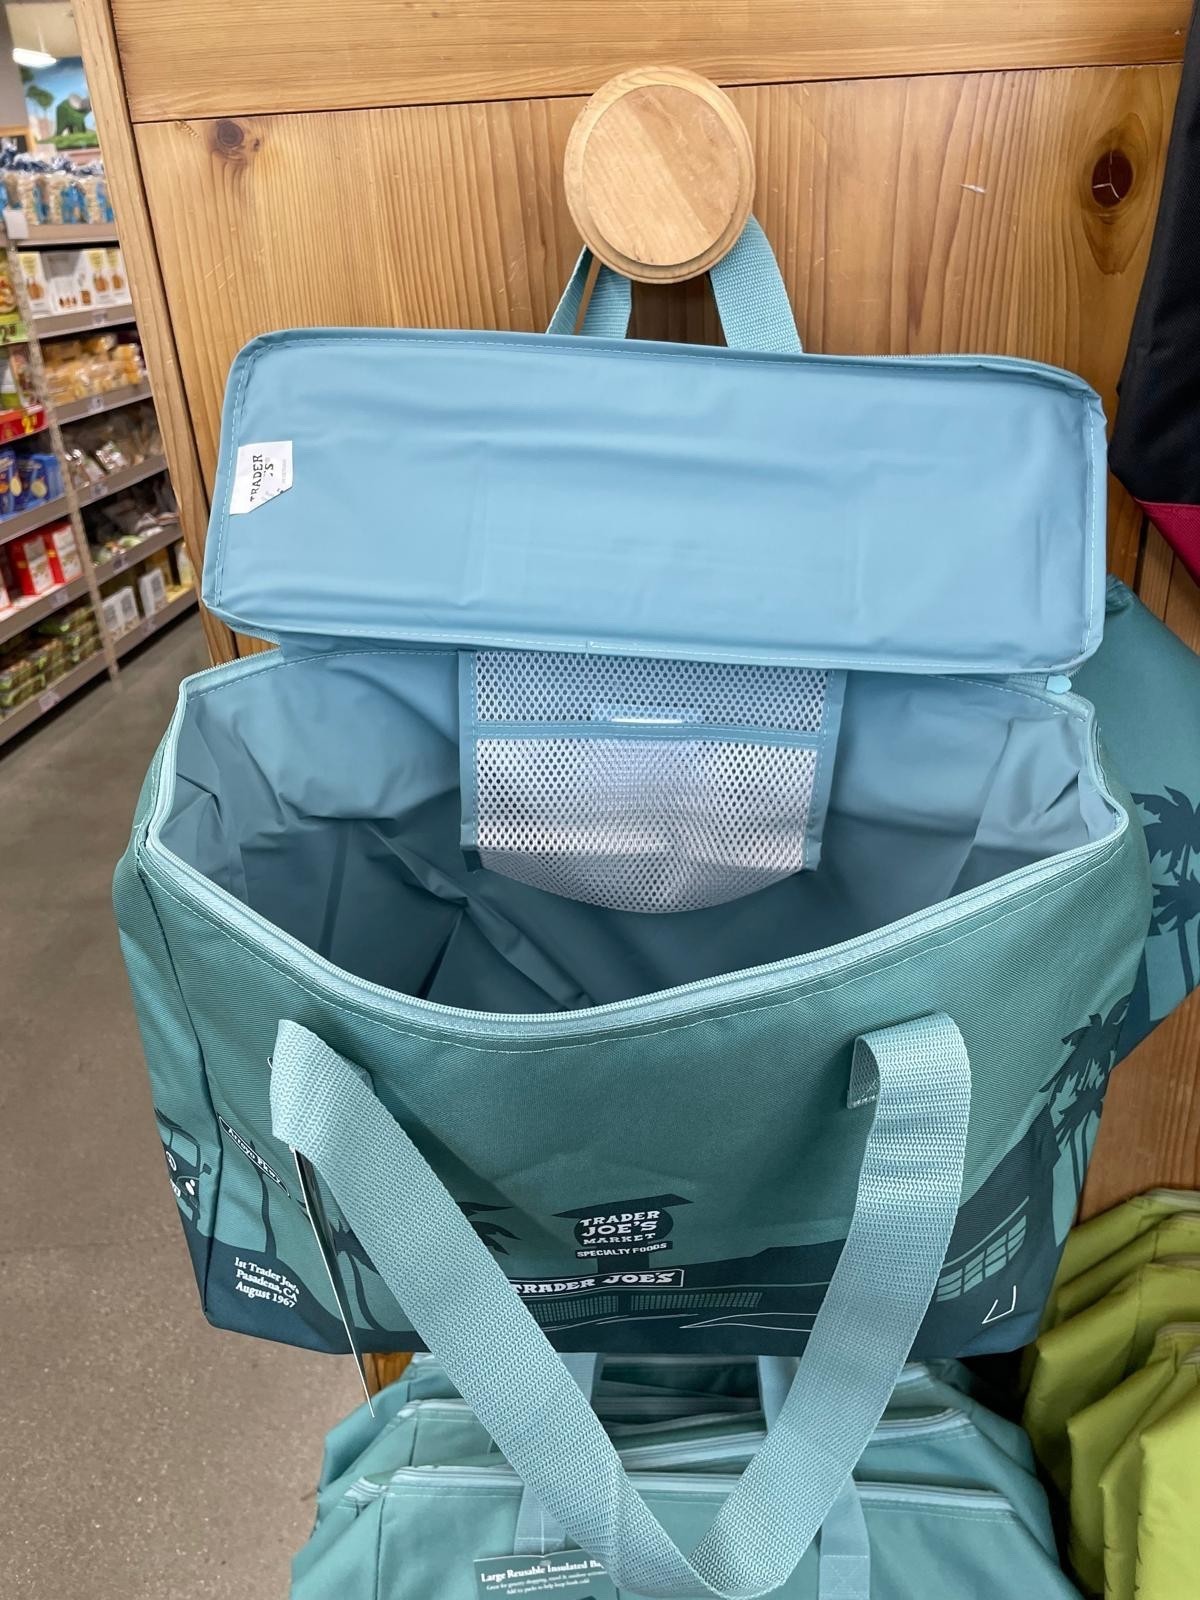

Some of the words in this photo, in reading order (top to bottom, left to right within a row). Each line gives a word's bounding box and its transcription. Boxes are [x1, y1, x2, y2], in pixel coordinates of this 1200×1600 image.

[250, 454, 263, 502] TRADER
[580, 1210, 661, 1227] TRADER
[581, 1220, 659, 1237] JOE'S
[583, 1232, 656, 1245] MARKET
[577, 1247, 630, 1258] SPECIALTY
[632, 1242, 668, 1254] FOODS
[234, 1256, 247, 1269] 1st
[248, 1262, 281, 1282] Trader
[602, 1272, 676, 1285] JOE'S
[235, 1268, 283, 1294] Pasadena,
[282, 1287, 298, 1303] CA
[235, 1280, 271, 1300] August
[272, 1293, 296, 1308] 1967
[480, 1572, 506, 1584] Large
[507, 1565, 546, 1579] Reusable
[547, 1560, 588, 1573] Insulated
[589, 1559, 604, 1569] Ba
